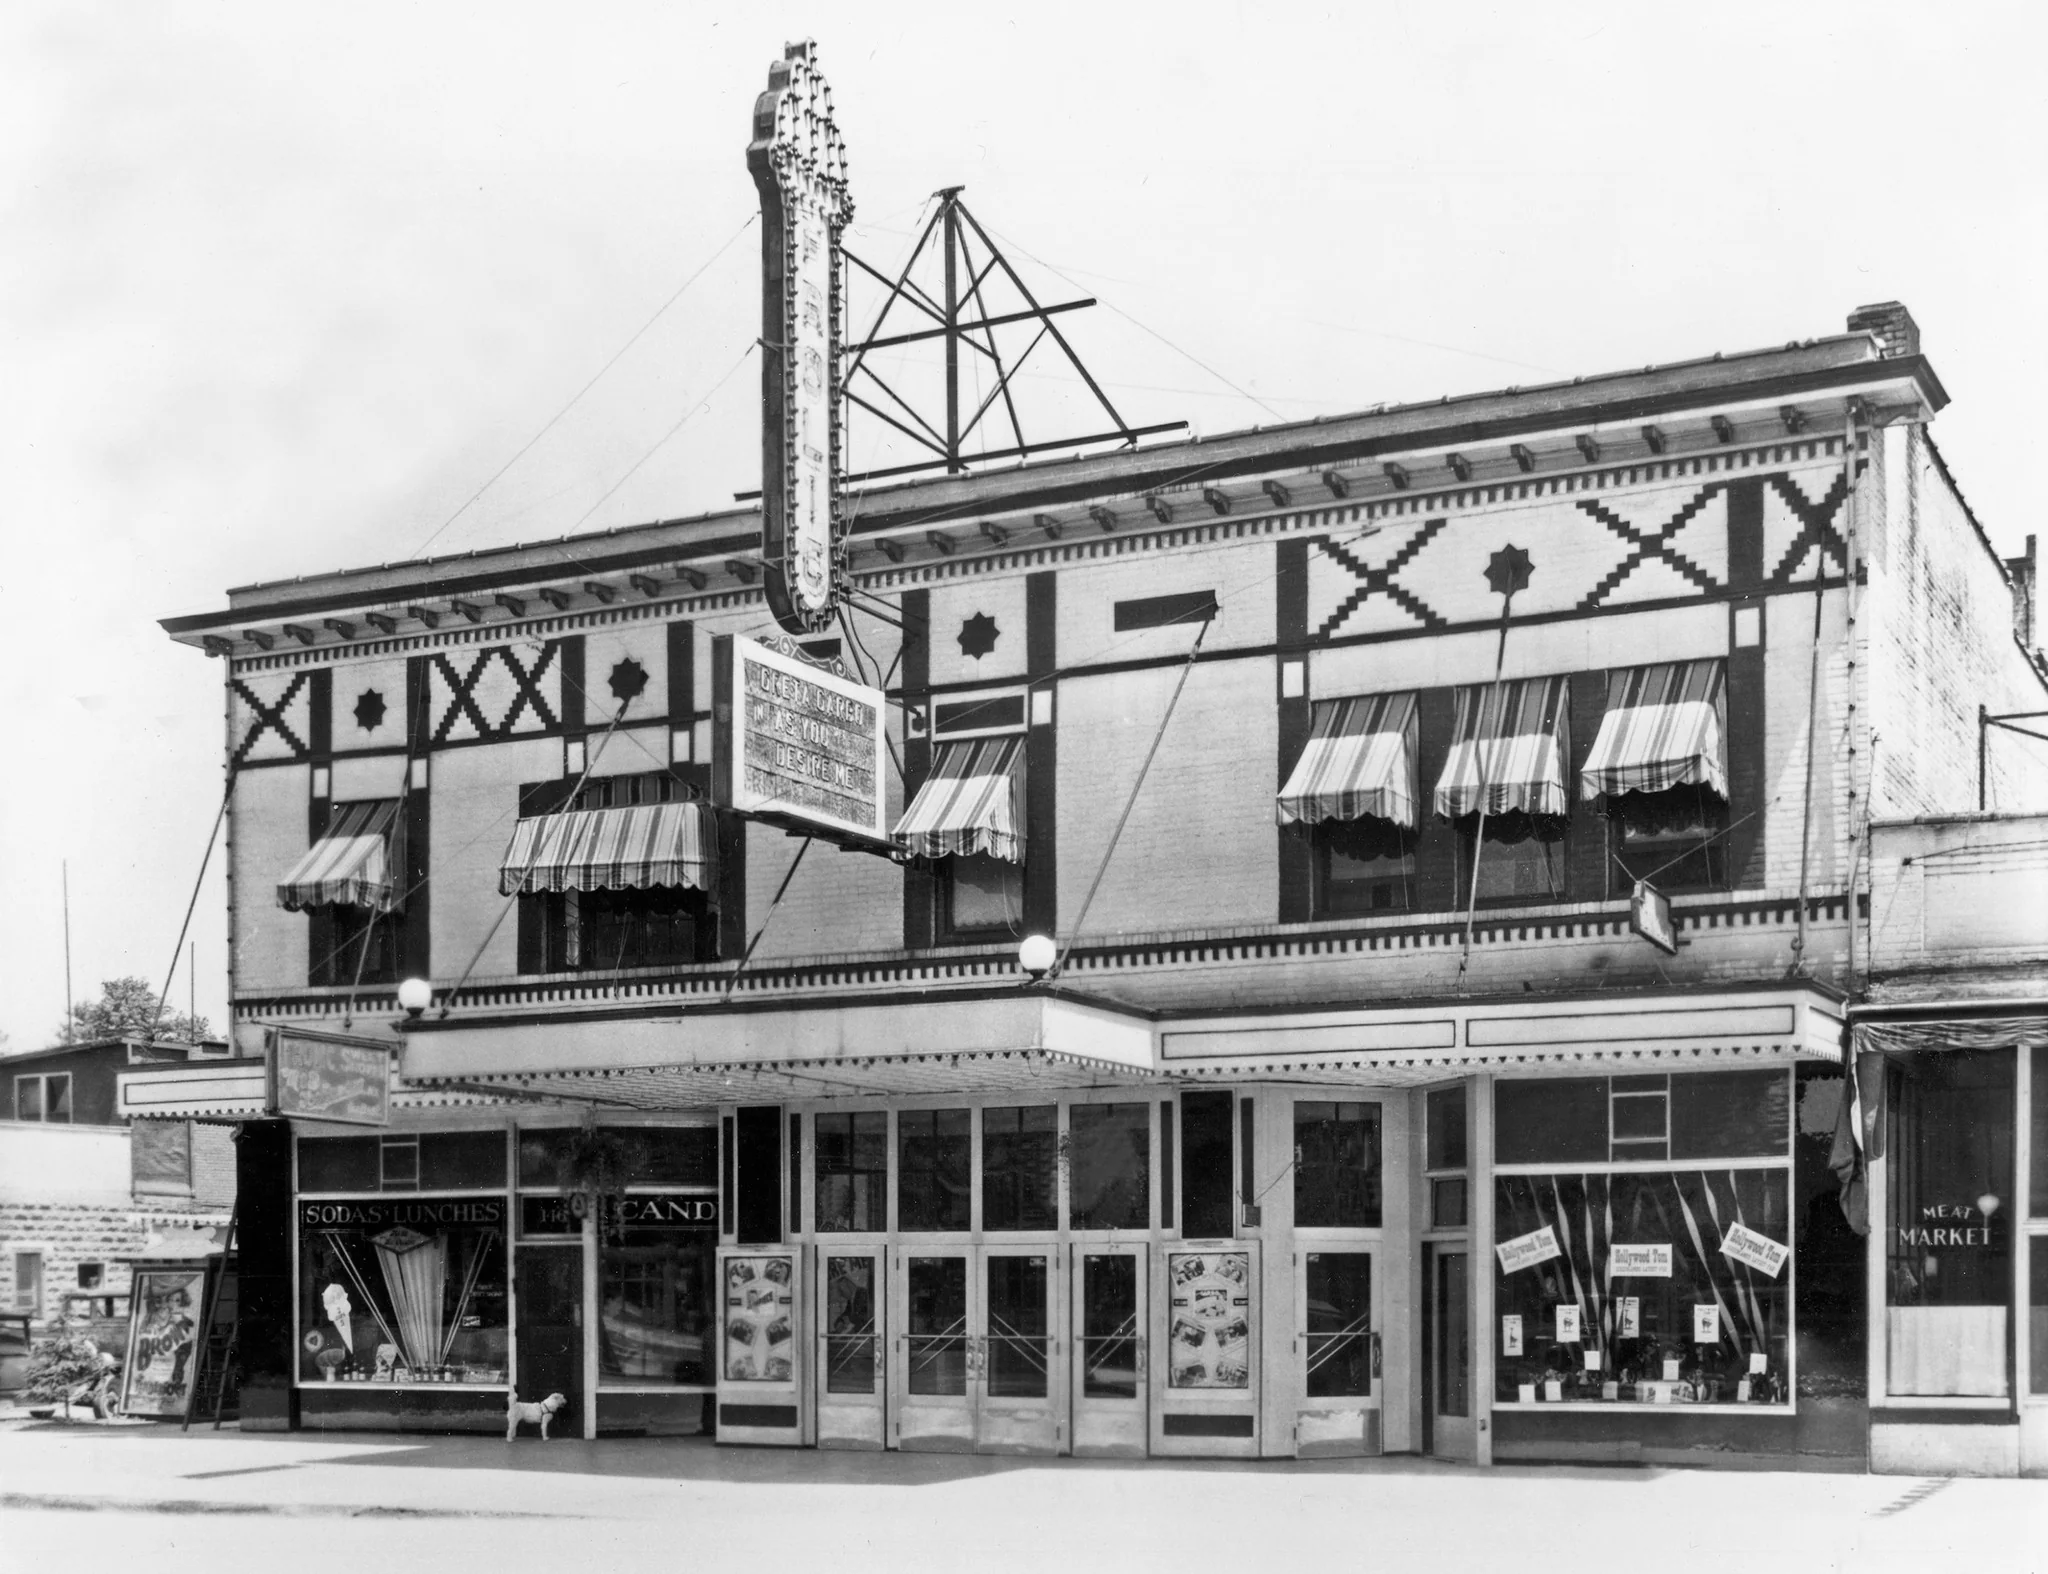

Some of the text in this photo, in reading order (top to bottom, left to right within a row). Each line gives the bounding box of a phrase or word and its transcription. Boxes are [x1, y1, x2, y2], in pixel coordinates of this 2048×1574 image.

[761, 667, 863, 727] GRETA GARBO
[753, 704, 764, 722] IN
[801, 717, 829, 748] YOU
[776, 744, 831, 784] DESIRE
[306, 1202, 500, 1224] SODAS LUNCHES
[1923, 1204, 1973, 1220] MEAT
[1900, 1227, 1991, 1246] MARKET
[1615, 1248, 1650, 1266] Hollywood
